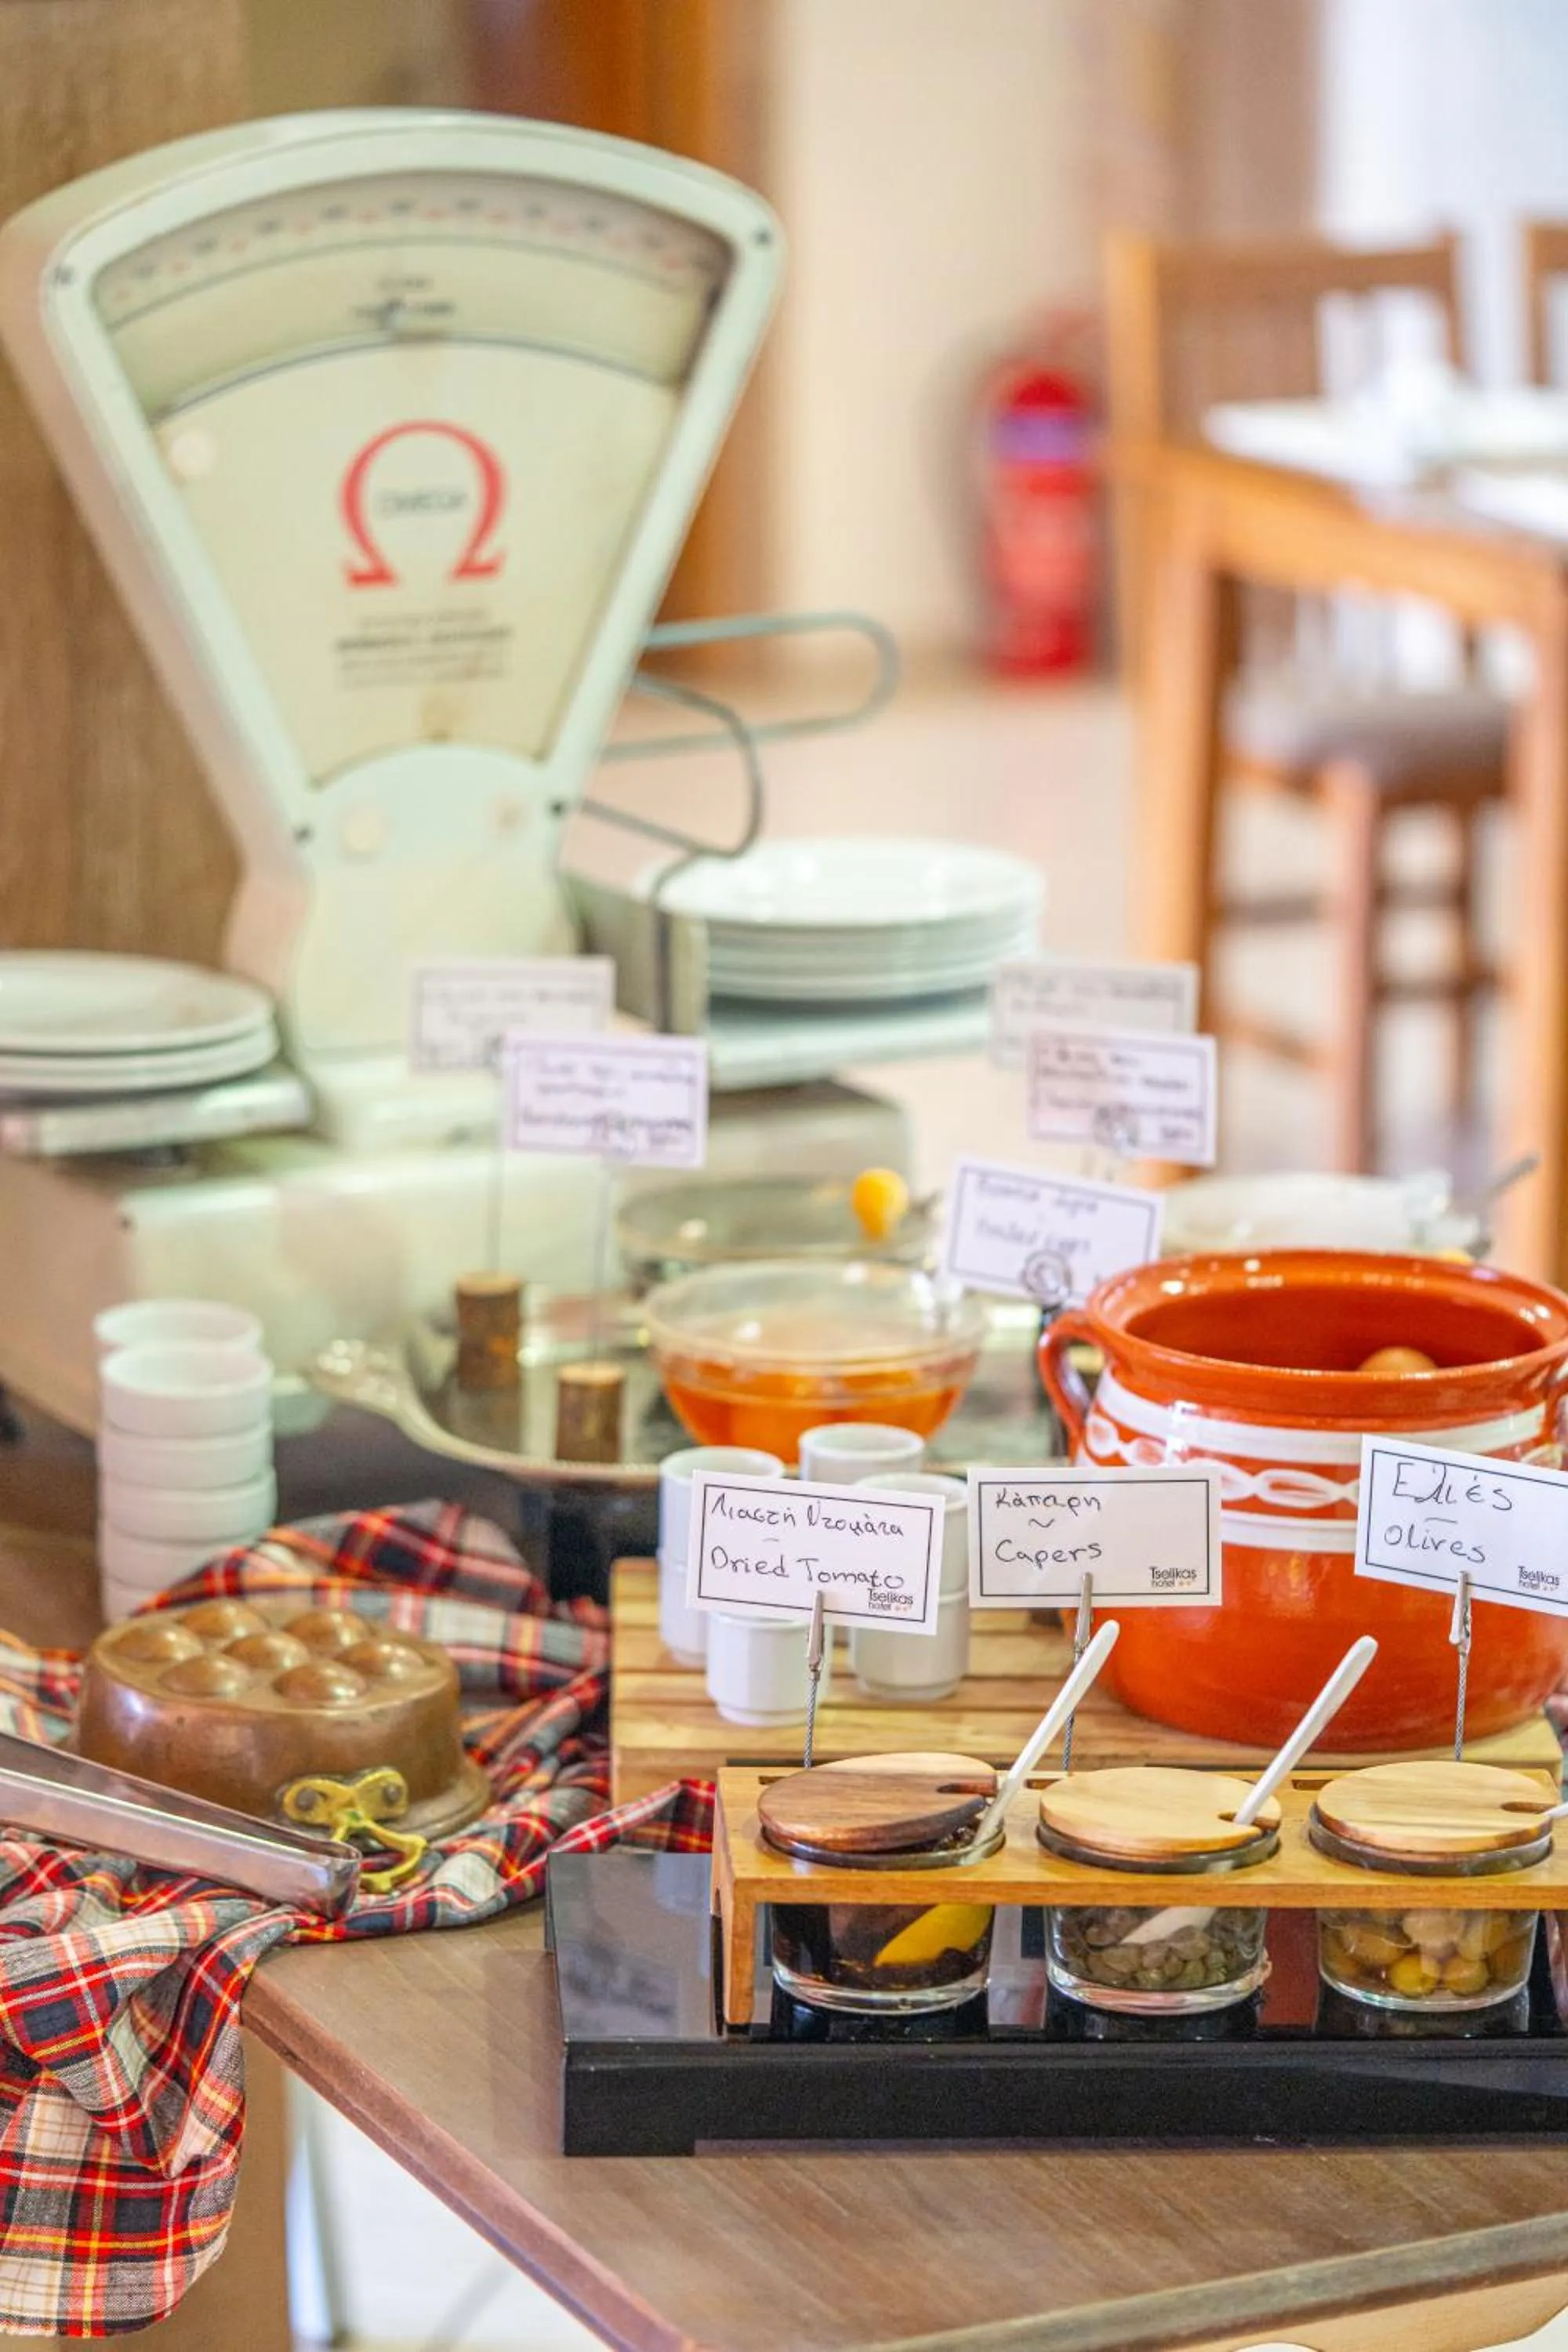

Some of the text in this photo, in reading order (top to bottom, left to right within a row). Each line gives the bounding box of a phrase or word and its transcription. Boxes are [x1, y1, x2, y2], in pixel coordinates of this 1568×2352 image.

[710, 1546, 905, 1589] Dried Tomato
[995, 1539, 1102, 1570] Capers
